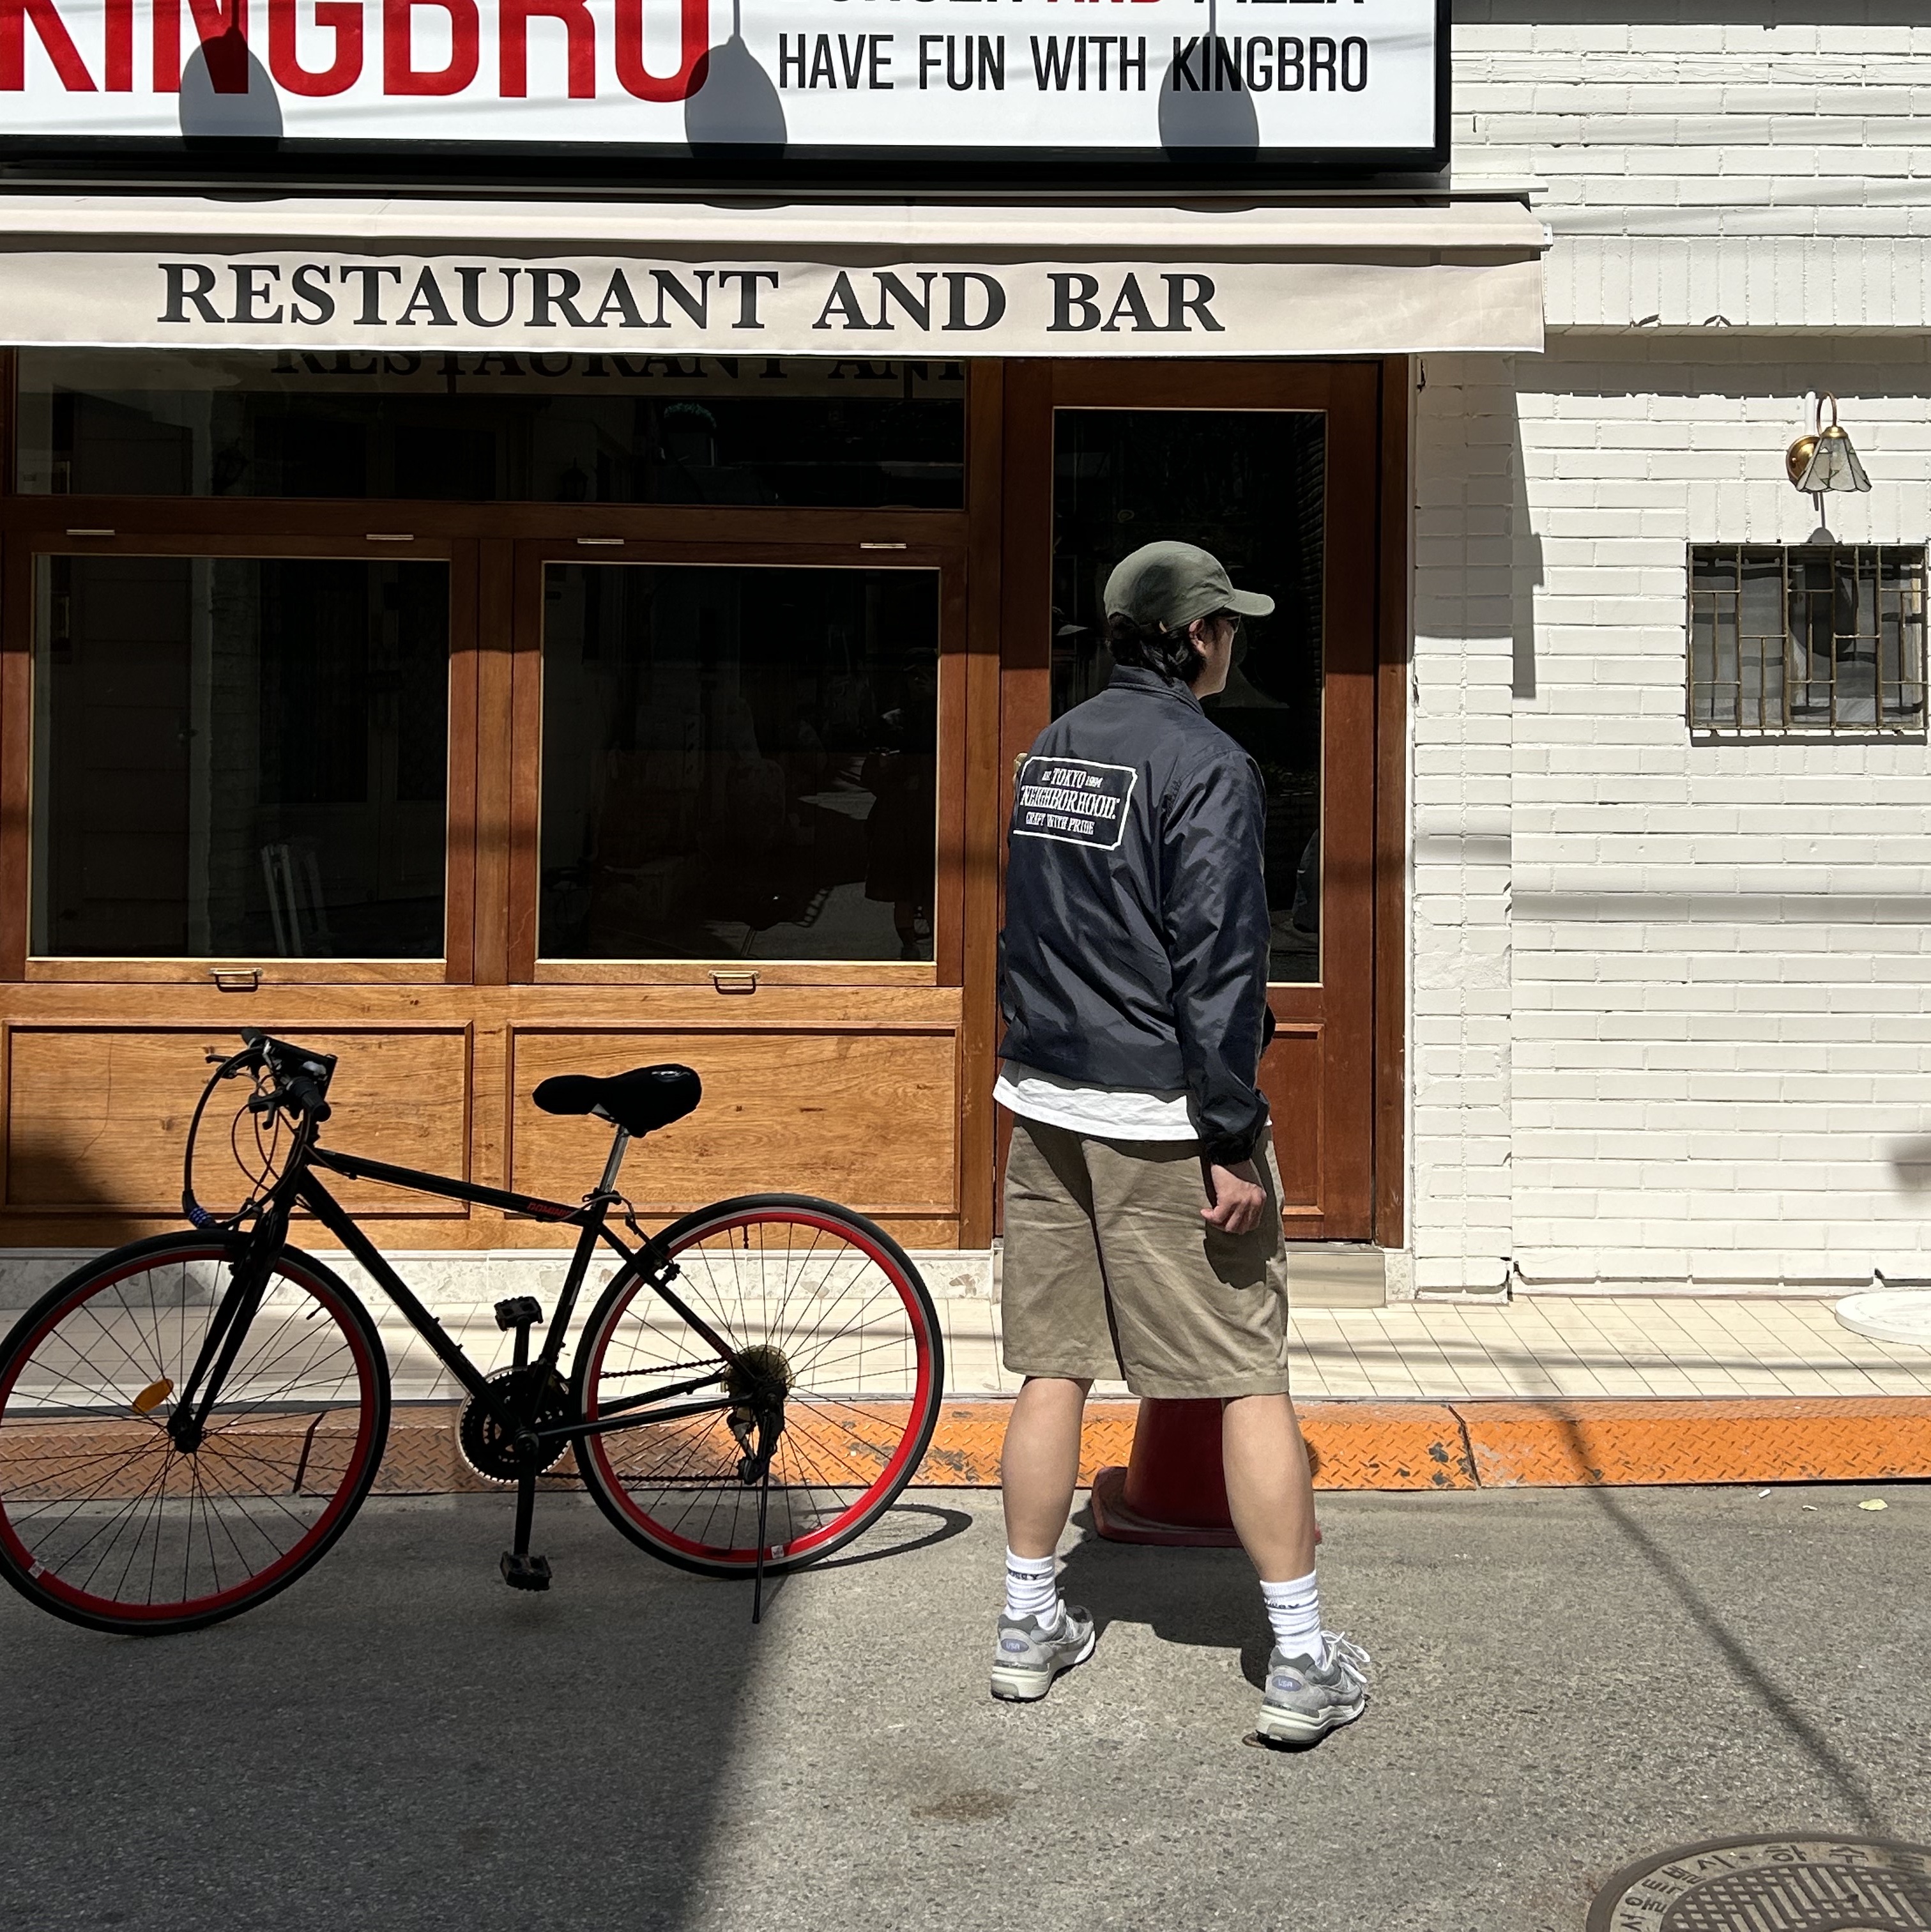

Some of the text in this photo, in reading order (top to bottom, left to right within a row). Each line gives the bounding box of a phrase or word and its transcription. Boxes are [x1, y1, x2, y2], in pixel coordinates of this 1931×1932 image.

[779, 33, 1368, 92] HAVE FUN WITH KINGBRO
[158, 263, 1226, 332] RESTAURANT AND BAR
[1051, 768, 1087, 788] TOKYO
[1046, 813, 1070, 830] WITH
[1067, 817, 1095, 835] PRIDE
